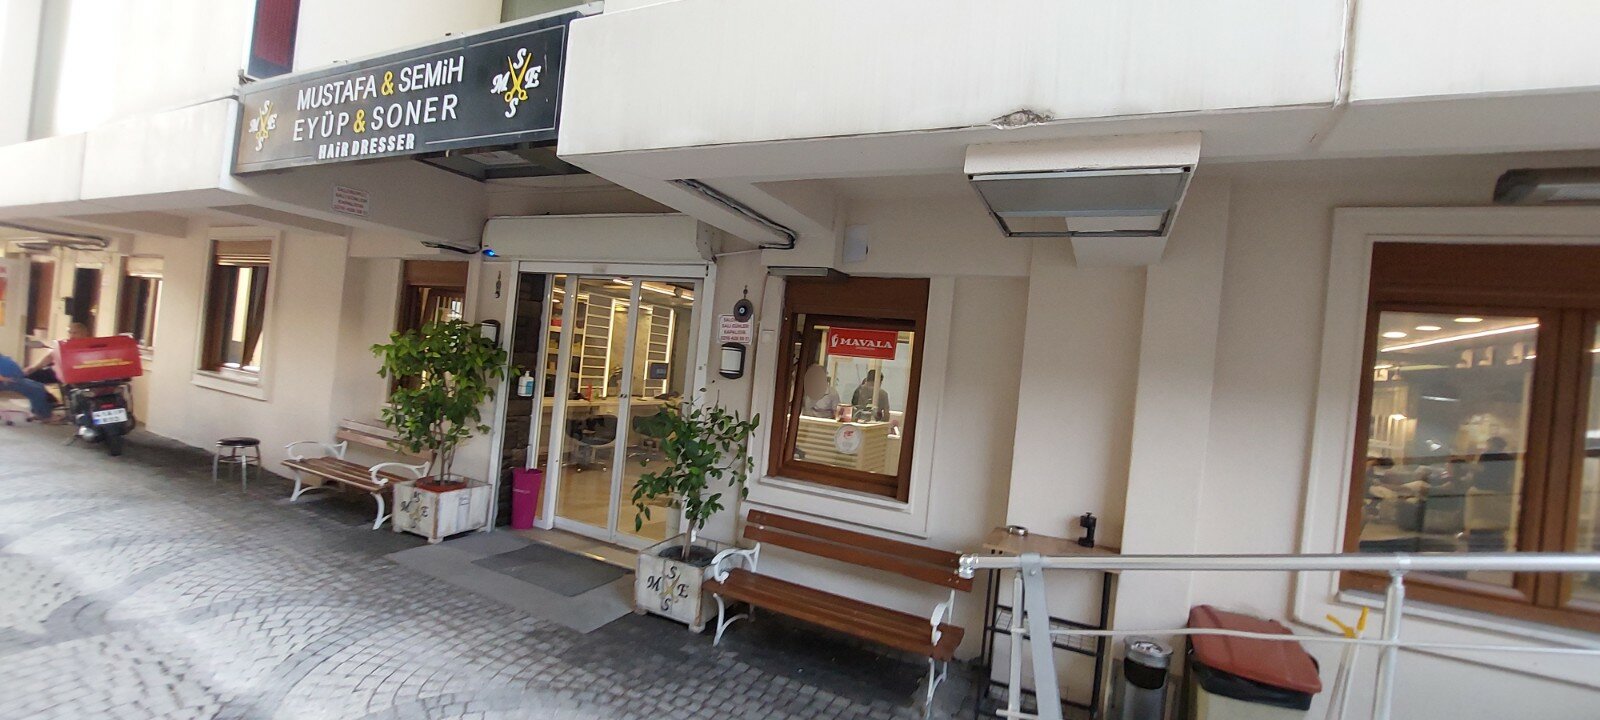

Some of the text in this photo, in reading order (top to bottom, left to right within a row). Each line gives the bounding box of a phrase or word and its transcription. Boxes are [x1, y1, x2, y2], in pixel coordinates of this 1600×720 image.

[512, 48, 527, 70] S
[297, 74, 377, 111] MUSTAFA
[380, 70, 394, 96] &
[490, 66, 542, 94] M E
[293, 94, 458, 142] EYÜP & SONER
[505, 98, 519, 118] S
[351, 133, 415, 156] DRESSER
[839, 337, 893, 349] MAVALA
[666, 565, 678, 579] S
[646, 575, 662, 592] M
